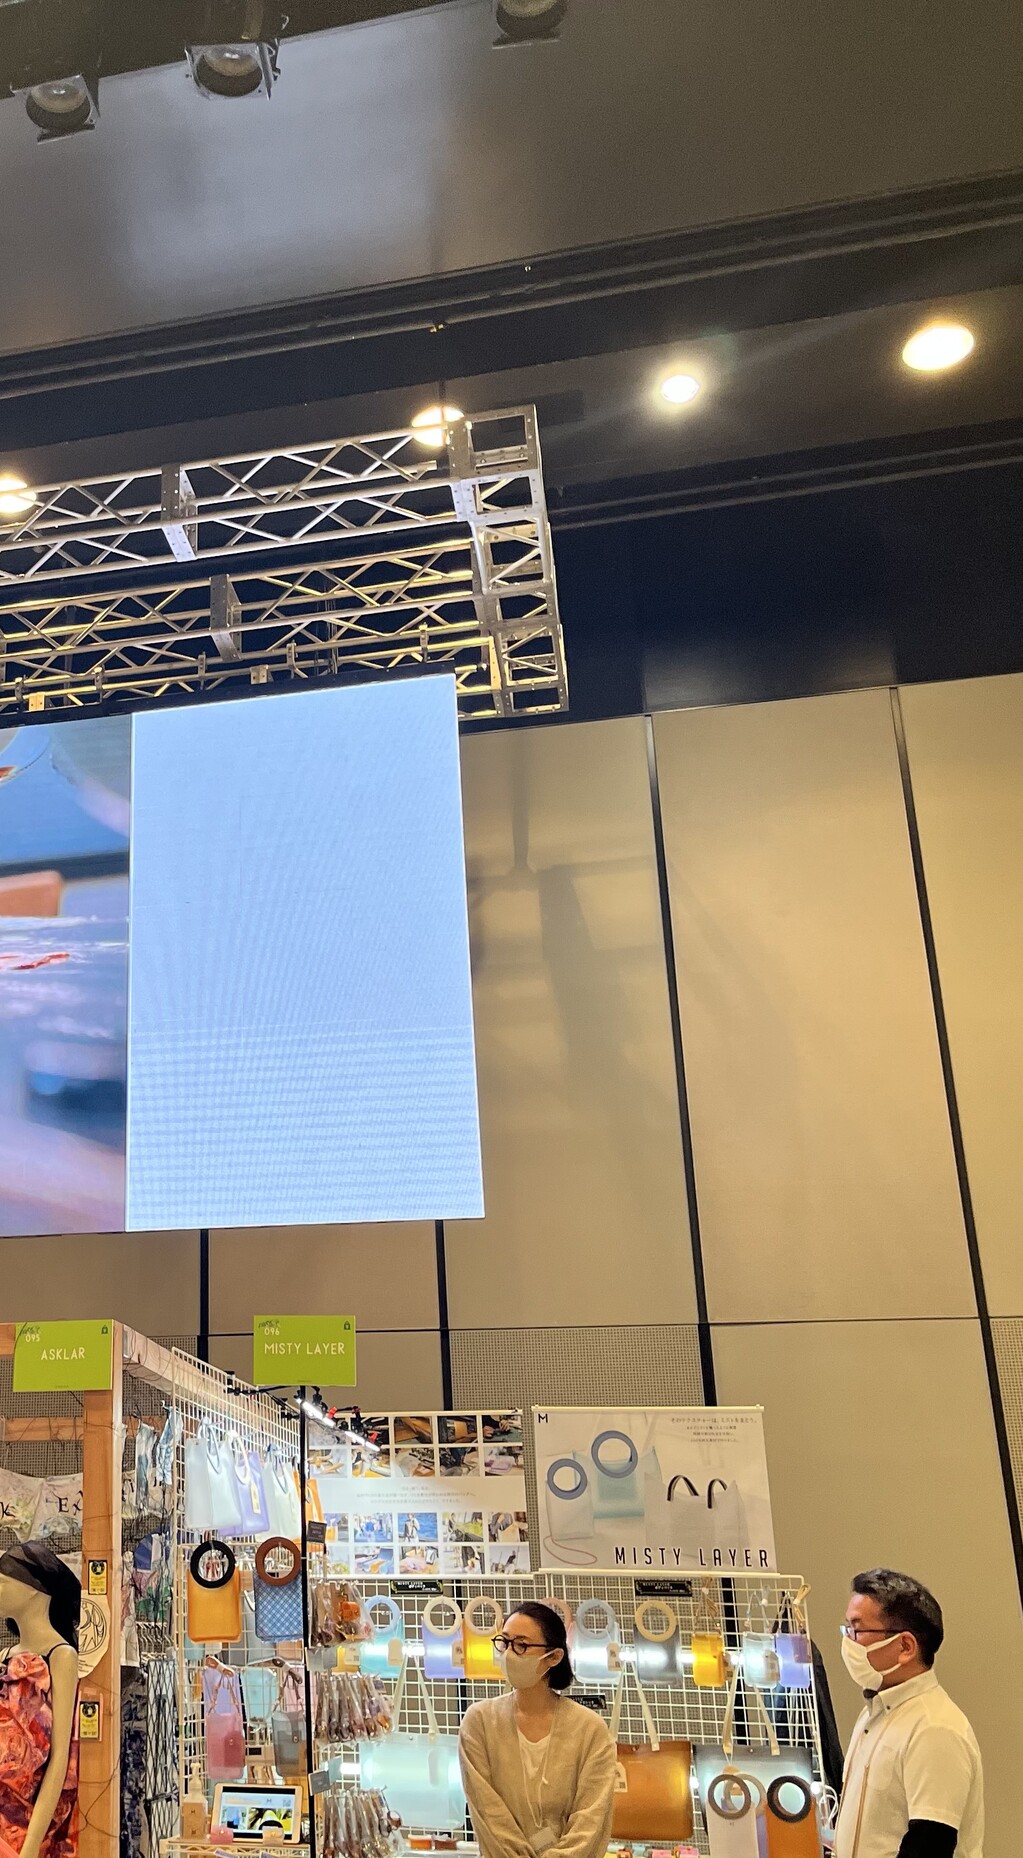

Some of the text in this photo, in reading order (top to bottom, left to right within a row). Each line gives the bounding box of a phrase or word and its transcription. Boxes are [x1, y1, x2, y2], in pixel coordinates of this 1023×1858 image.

[264, 1327, 280, 1336] 096
[25, 1334, 40, 1343] 095
[40, 1346, 85, 1360] ASKLAR
[264, 1342, 345, 1355] MISTY LAYER
[615, 1547, 769, 1567] MISTY LAYER
